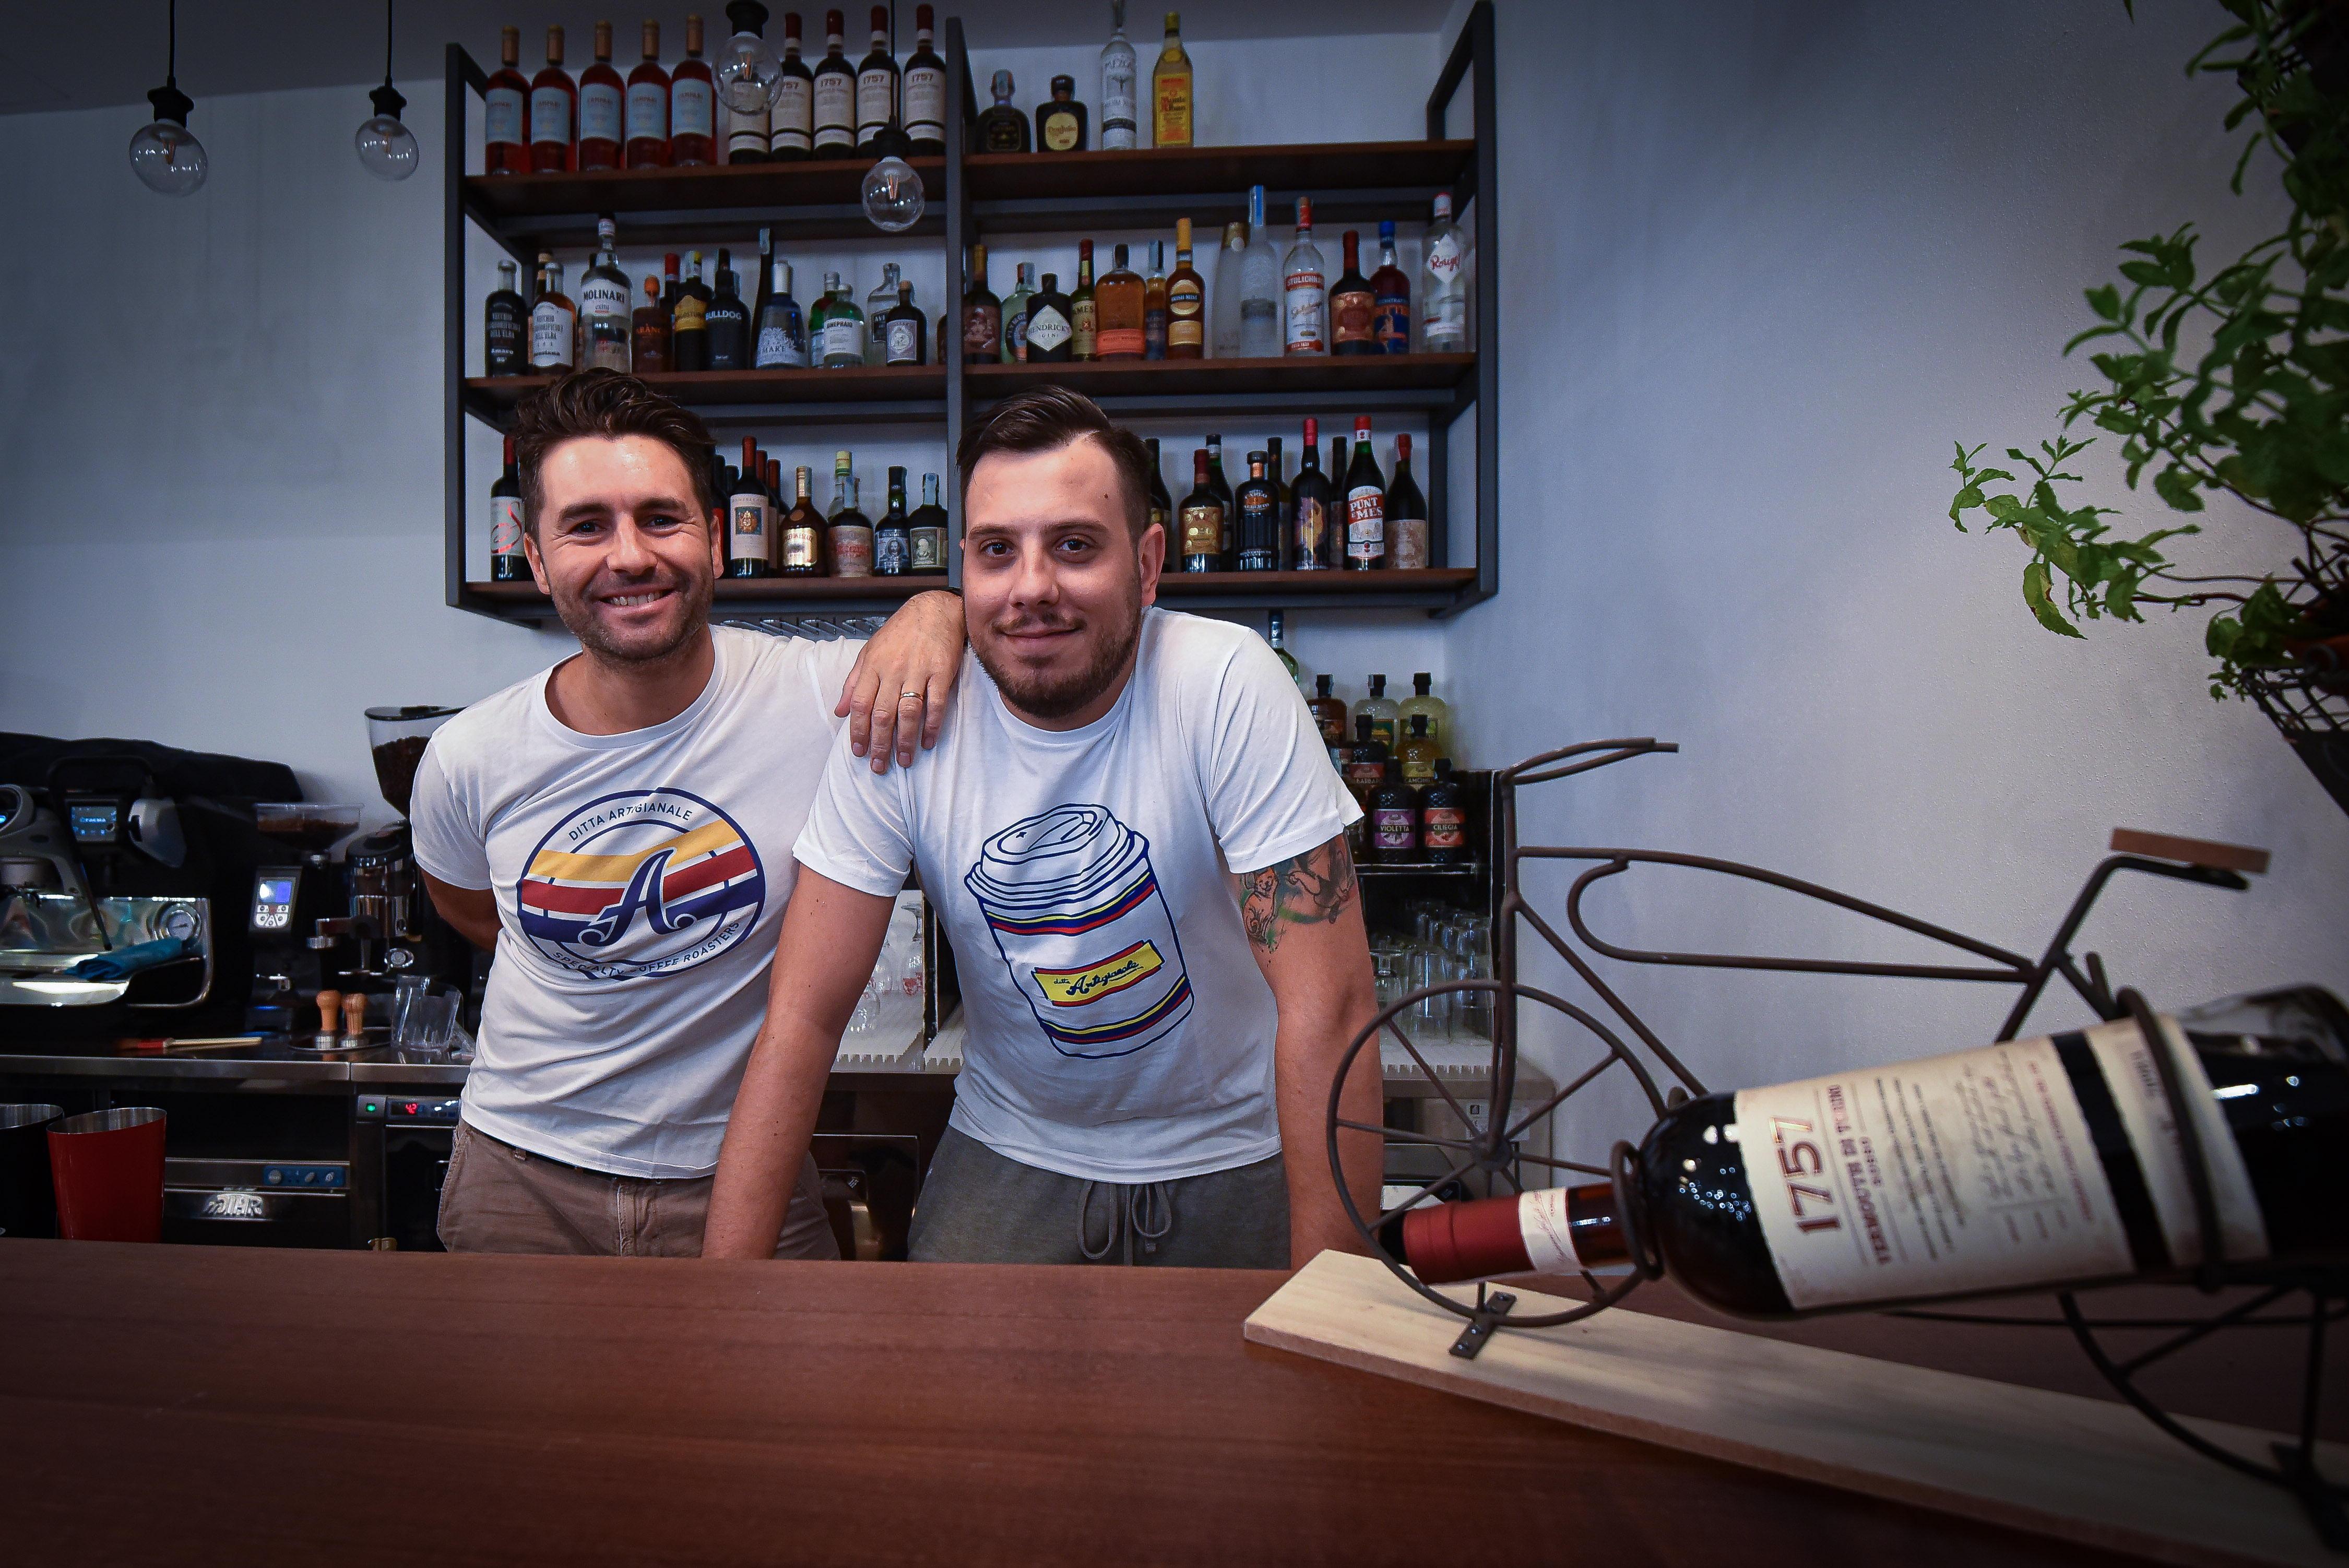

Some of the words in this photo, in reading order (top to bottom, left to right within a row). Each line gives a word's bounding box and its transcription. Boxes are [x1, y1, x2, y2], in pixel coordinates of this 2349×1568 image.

[821, 77, 841, 87] 1757
[863, 75, 884, 85] 1757
[912, 73, 933, 82] 1757
[584, 289, 625, 303] MOLINARI
[705, 310, 742, 321] BULLDOG
[1350, 497, 1378, 512] PUNT
[1357, 507, 1383, 520] MES
[568, 816, 606, 842] DITTA
[609, 802, 693, 822] ARTIGIANALE
[631, 958, 680, 972] OFFEE
[683, 922, 740, 963] ROASTERS
[1065, 959, 1140, 996] Artigianale
[1840, 1137, 1858, 1156] DI
[1769, 1115, 1841, 1234] 1757
[1847, 1161, 1893, 1265] VERMOUTH
